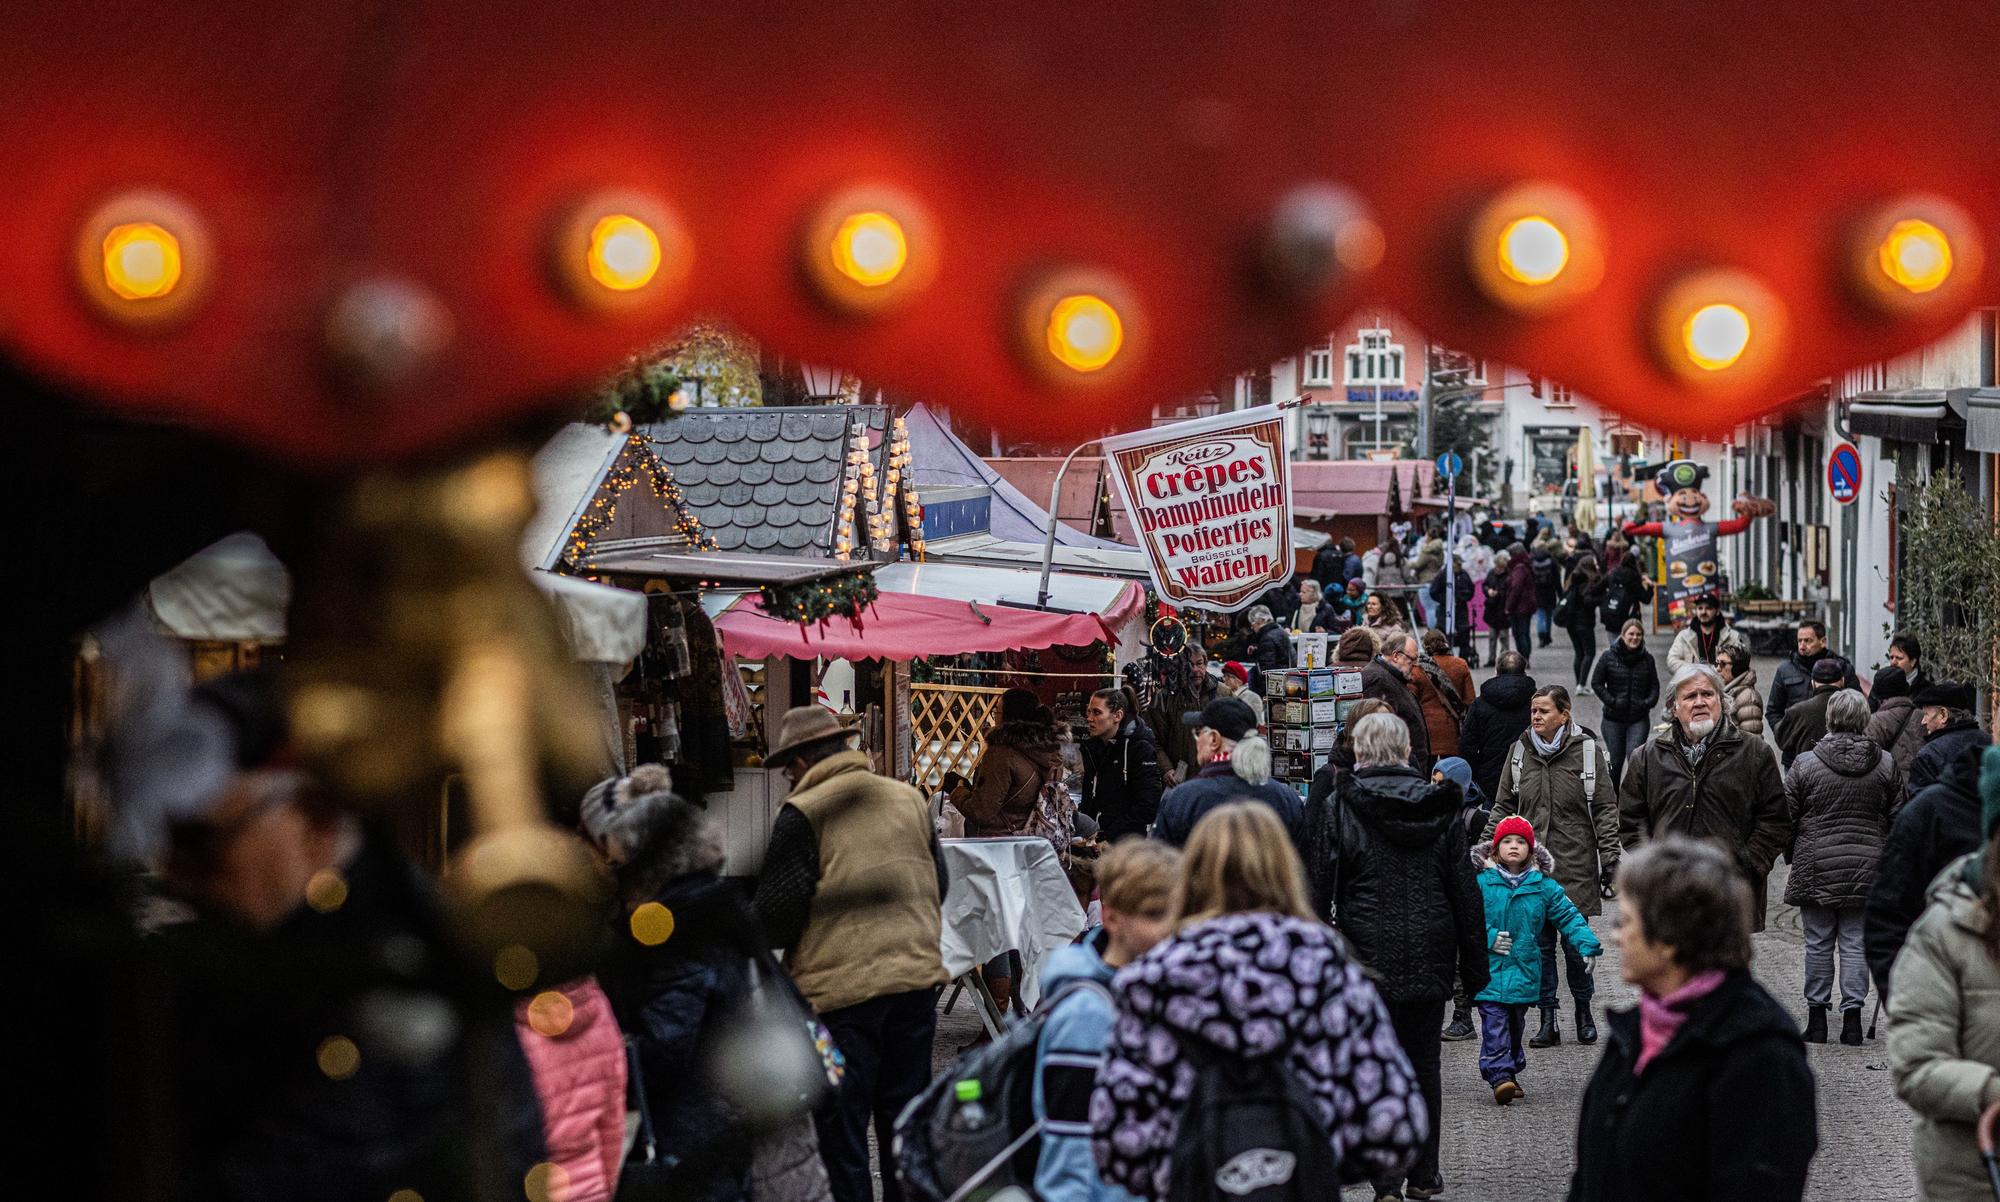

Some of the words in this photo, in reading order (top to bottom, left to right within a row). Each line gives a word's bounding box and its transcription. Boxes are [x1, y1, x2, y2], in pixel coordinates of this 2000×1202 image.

[1166, 444, 1228, 466] Reitz
[1147, 455, 1265, 499] Crêpes
[1138, 482, 1284, 533] Dampfnudeln
[1162, 516, 1273, 556] Poffertjes
[1191, 545, 1249, 564] BRÜSSELER
[1177, 553, 1270, 589] Waffeln
